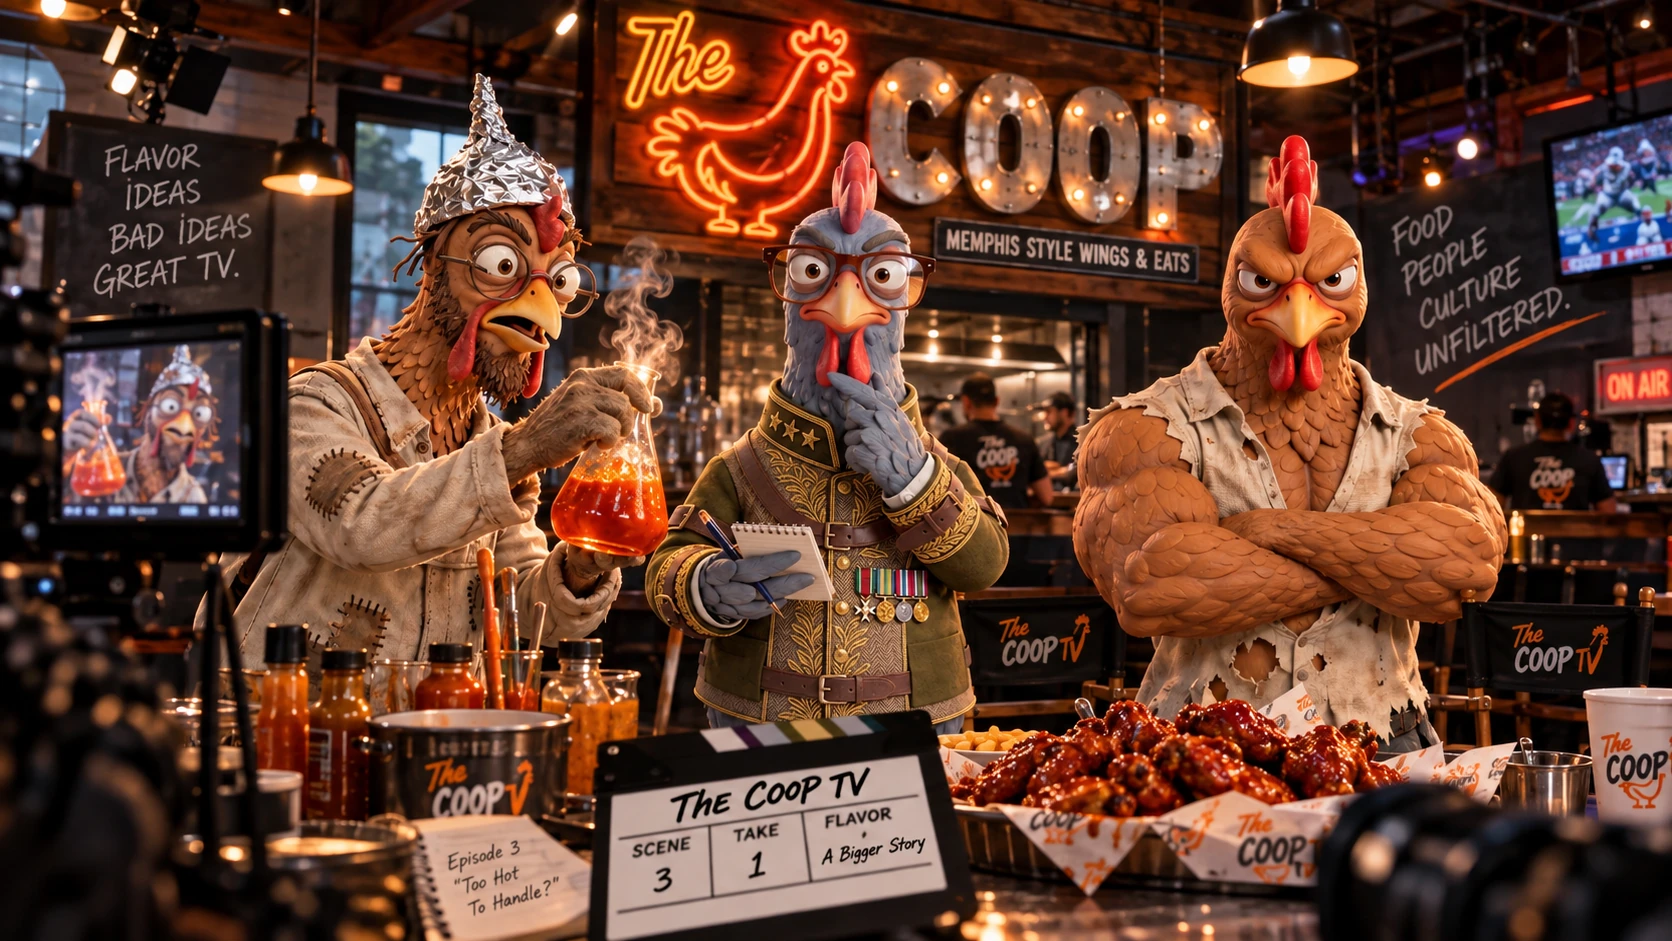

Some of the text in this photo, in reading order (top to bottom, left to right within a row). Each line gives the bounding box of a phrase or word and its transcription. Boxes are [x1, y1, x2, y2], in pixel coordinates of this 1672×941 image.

[624, 10, 736, 109] The
[867, 57, 1224, 231] COOP
[105, 143, 201, 178] FLAVOR
[108, 222, 164, 255] BAD
[1391, 205, 1453, 257] FOOD
[946, 228, 1191, 274] MEMPHIS STYLE WINGS & EATS
[1401, 226, 1488, 296] PEOPLE
[93, 248, 240, 299] GREAT TV.
[1419, 255, 1522, 329] CULTURE
[1606, 368, 1671, 401] ON AIR
[976, 445, 1020, 467] COOP
[977, 435, 1005, 449] The
[1529, 467, 1576, 490] COOP
[1533, 456, 1562, 470] The
[999, 616, 1029, 643] The
[1512, 622, 1544, 648] The
[1002, 635, 1059, 667] COOP
[1514, 640, 1604, 675] COOP TV
[1600, 732, 1633, 758] The
[424, 757, 468, 793] The
[829, 767, 871, 799] TV
[1606, 750, 1669, 784] COOP
[432, 780, 505, 818] COOP
[733, 823, 780, 843] TAKE
[825, 807, 892, 829] FLAVOR
[1237, 811, 1273, 837] The
[447, 840, 521, 873] Episode 3
[632, 836, 691, 858] SCENE
[821, 837, 926, 866] A Bigger Story
[1237, 835, 1308, 868] COOP
[493, 866, 519, 886] Hot
[653, 867, 673, 893] 3
[748, 851, 766, 879] 1
[467, 876, 559, 916] To Handle?"
